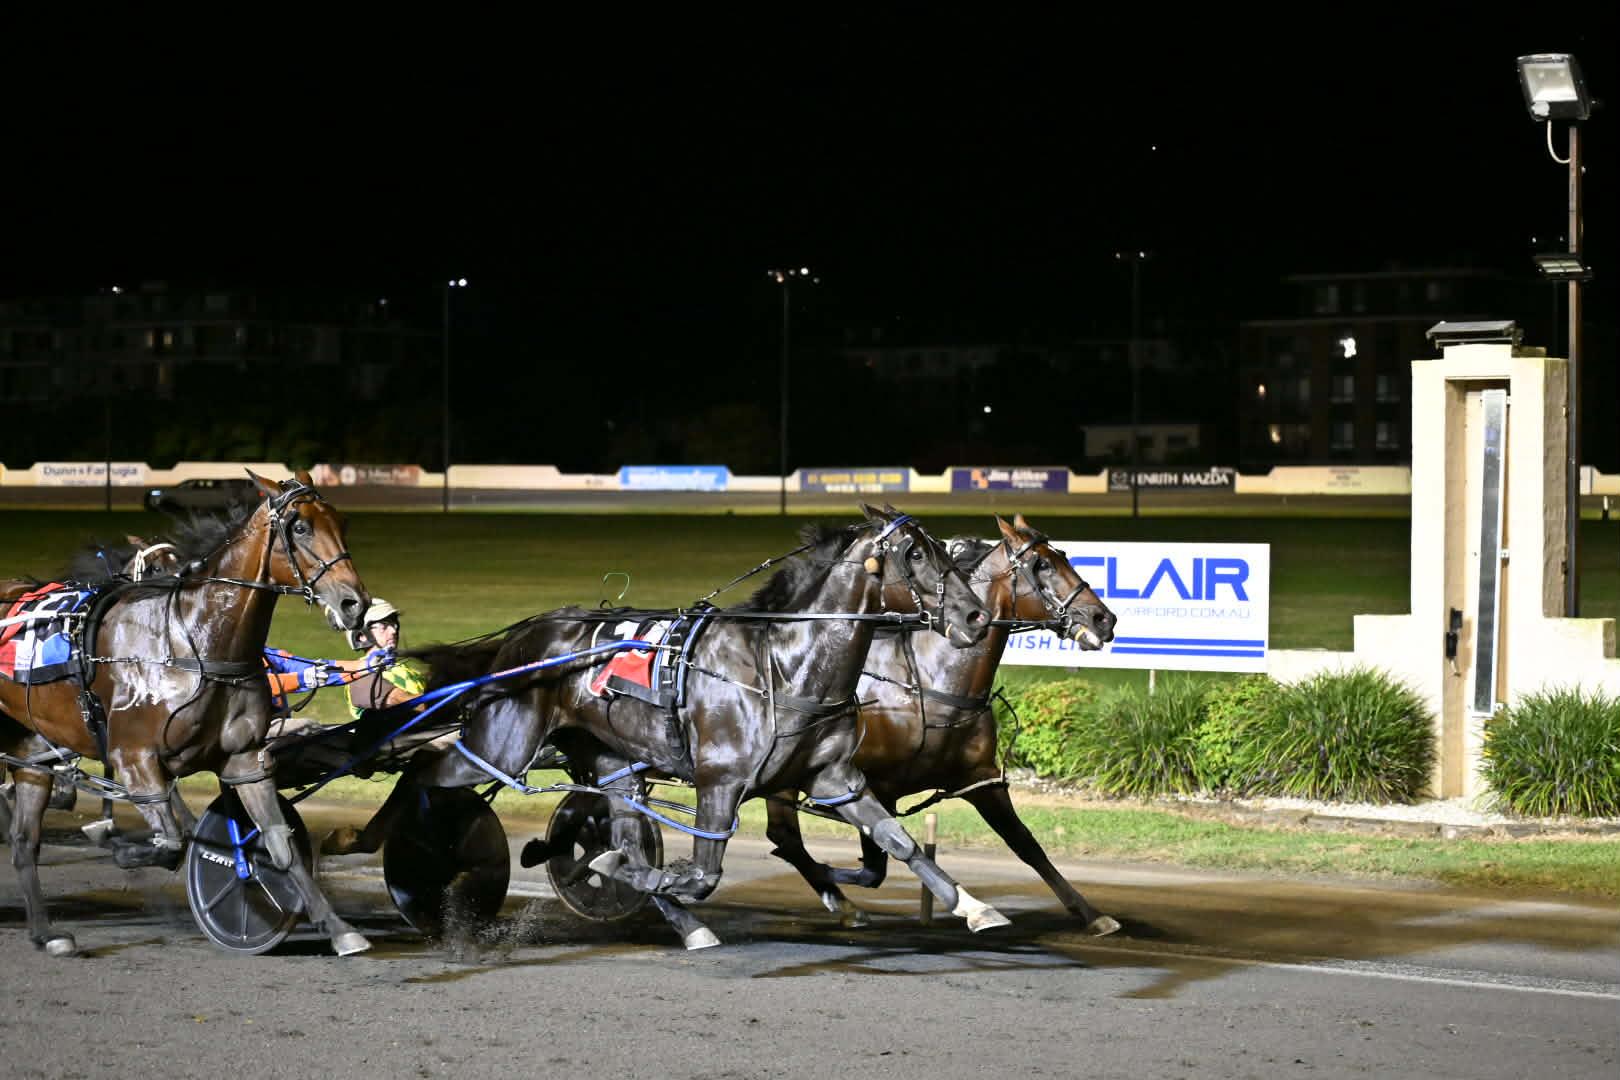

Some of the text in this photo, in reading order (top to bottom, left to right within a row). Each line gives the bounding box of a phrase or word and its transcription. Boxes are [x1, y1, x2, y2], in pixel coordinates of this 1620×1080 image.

[86, 466, 138, 478] Farugia
[1181, 472, 1229, 486] MAZDA
[1068, 556, 1250, 601] CLAIR
[1058, 638, 1081, 651] LI
